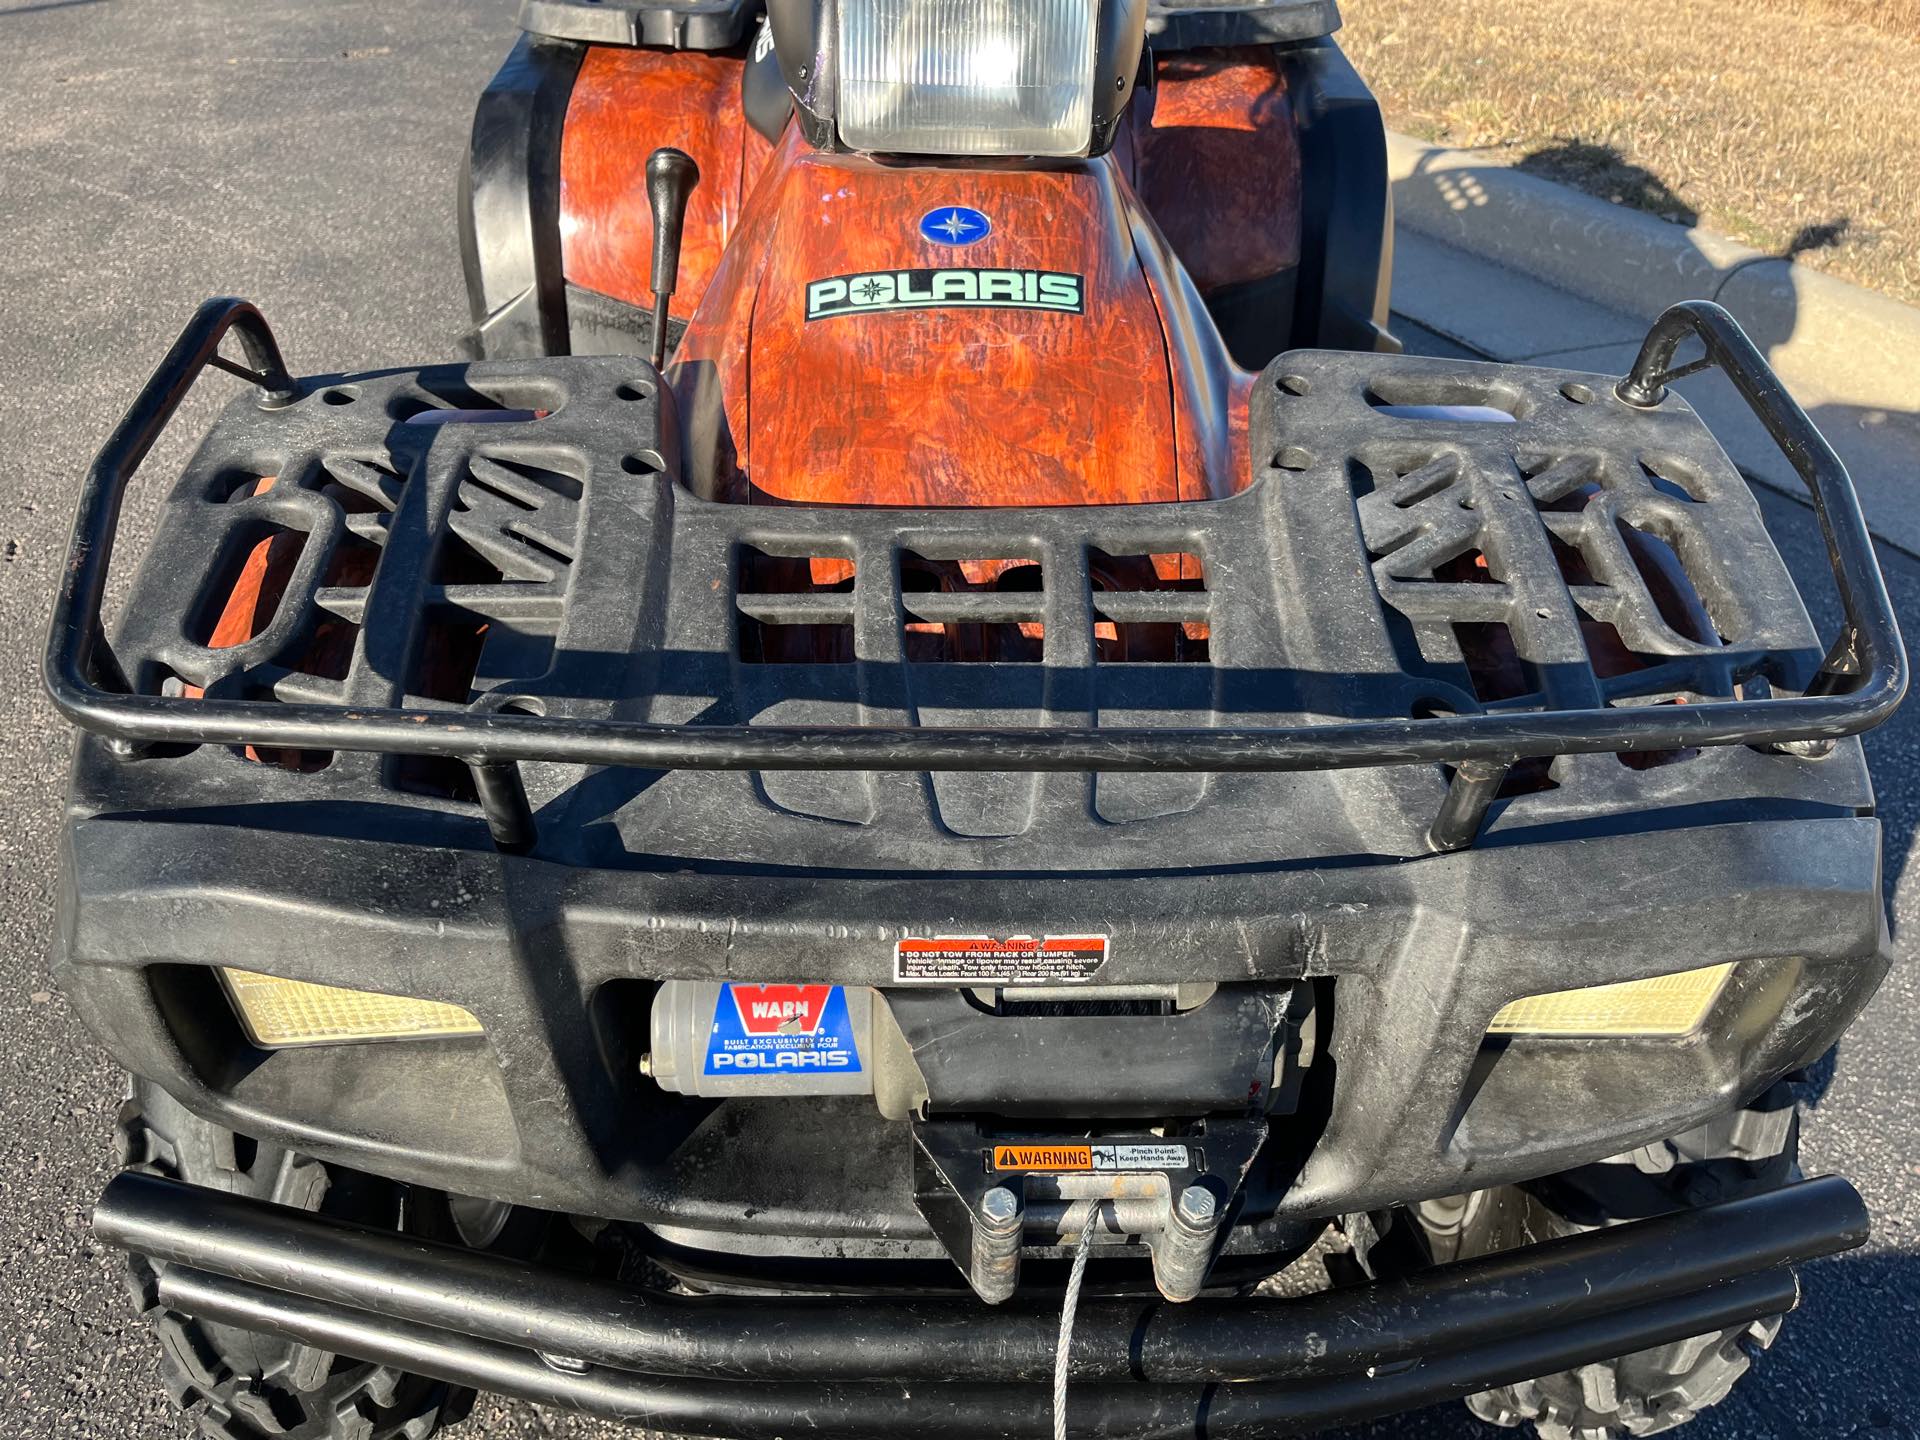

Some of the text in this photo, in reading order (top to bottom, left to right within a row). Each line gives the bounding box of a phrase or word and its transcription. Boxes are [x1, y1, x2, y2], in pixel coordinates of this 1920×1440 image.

[810, 271, 1080, 313] POLARIS
[752, 1001, 809, 1018] WARN
[713, 1051, 849, 1069] POLARIS
[1019, 1152, 1088, 1165] WARNING
